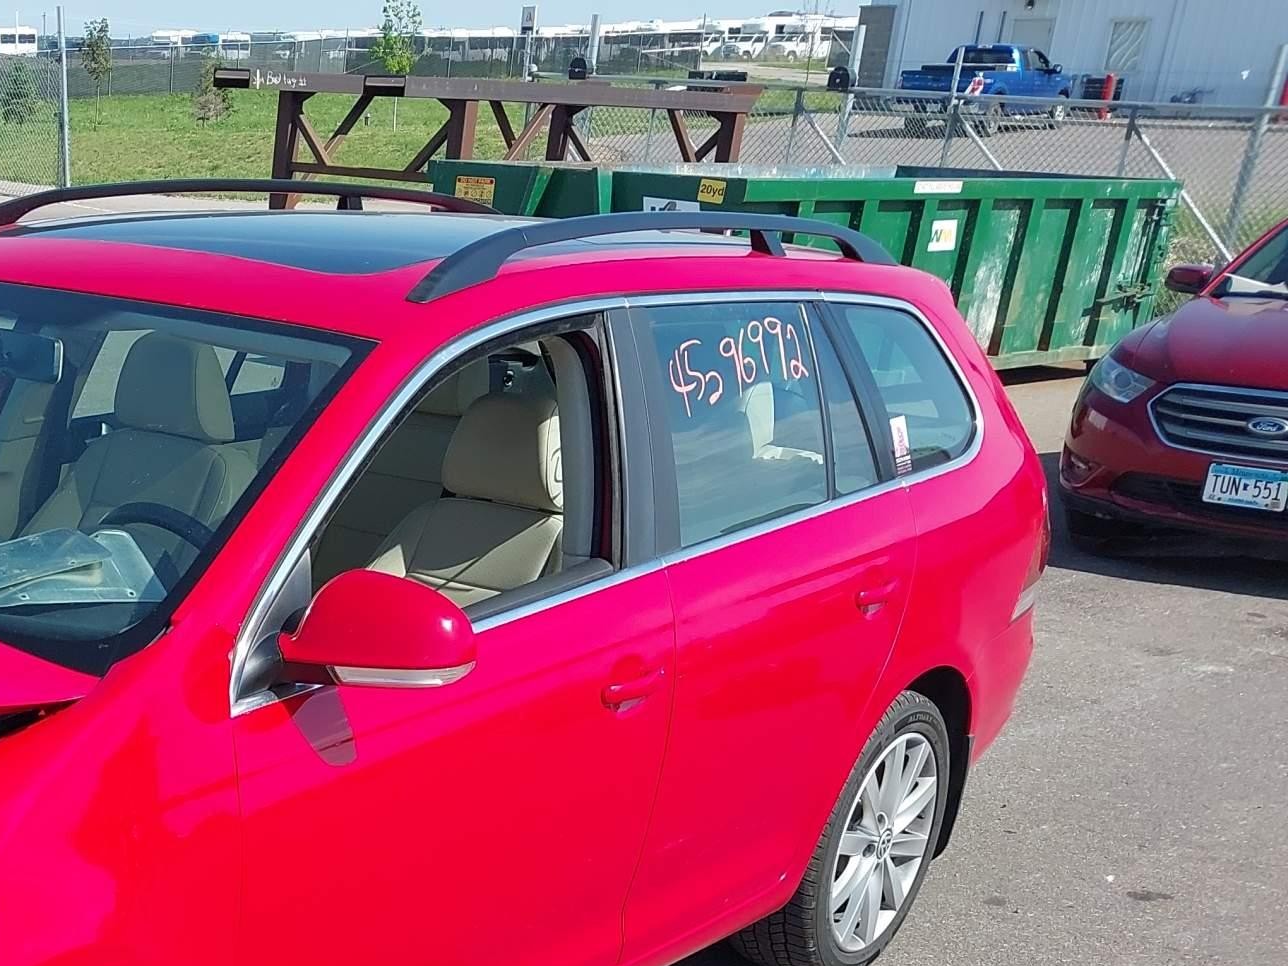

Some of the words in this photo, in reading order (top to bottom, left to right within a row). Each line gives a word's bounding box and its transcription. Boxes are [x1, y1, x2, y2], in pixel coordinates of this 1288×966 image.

[700, 183, 724, 197] 20yd
[1256, 420, 1280, 431] Ford
[1212, 474, 1242, 496] TUN
[1252, 480, 1282, 501] 551
